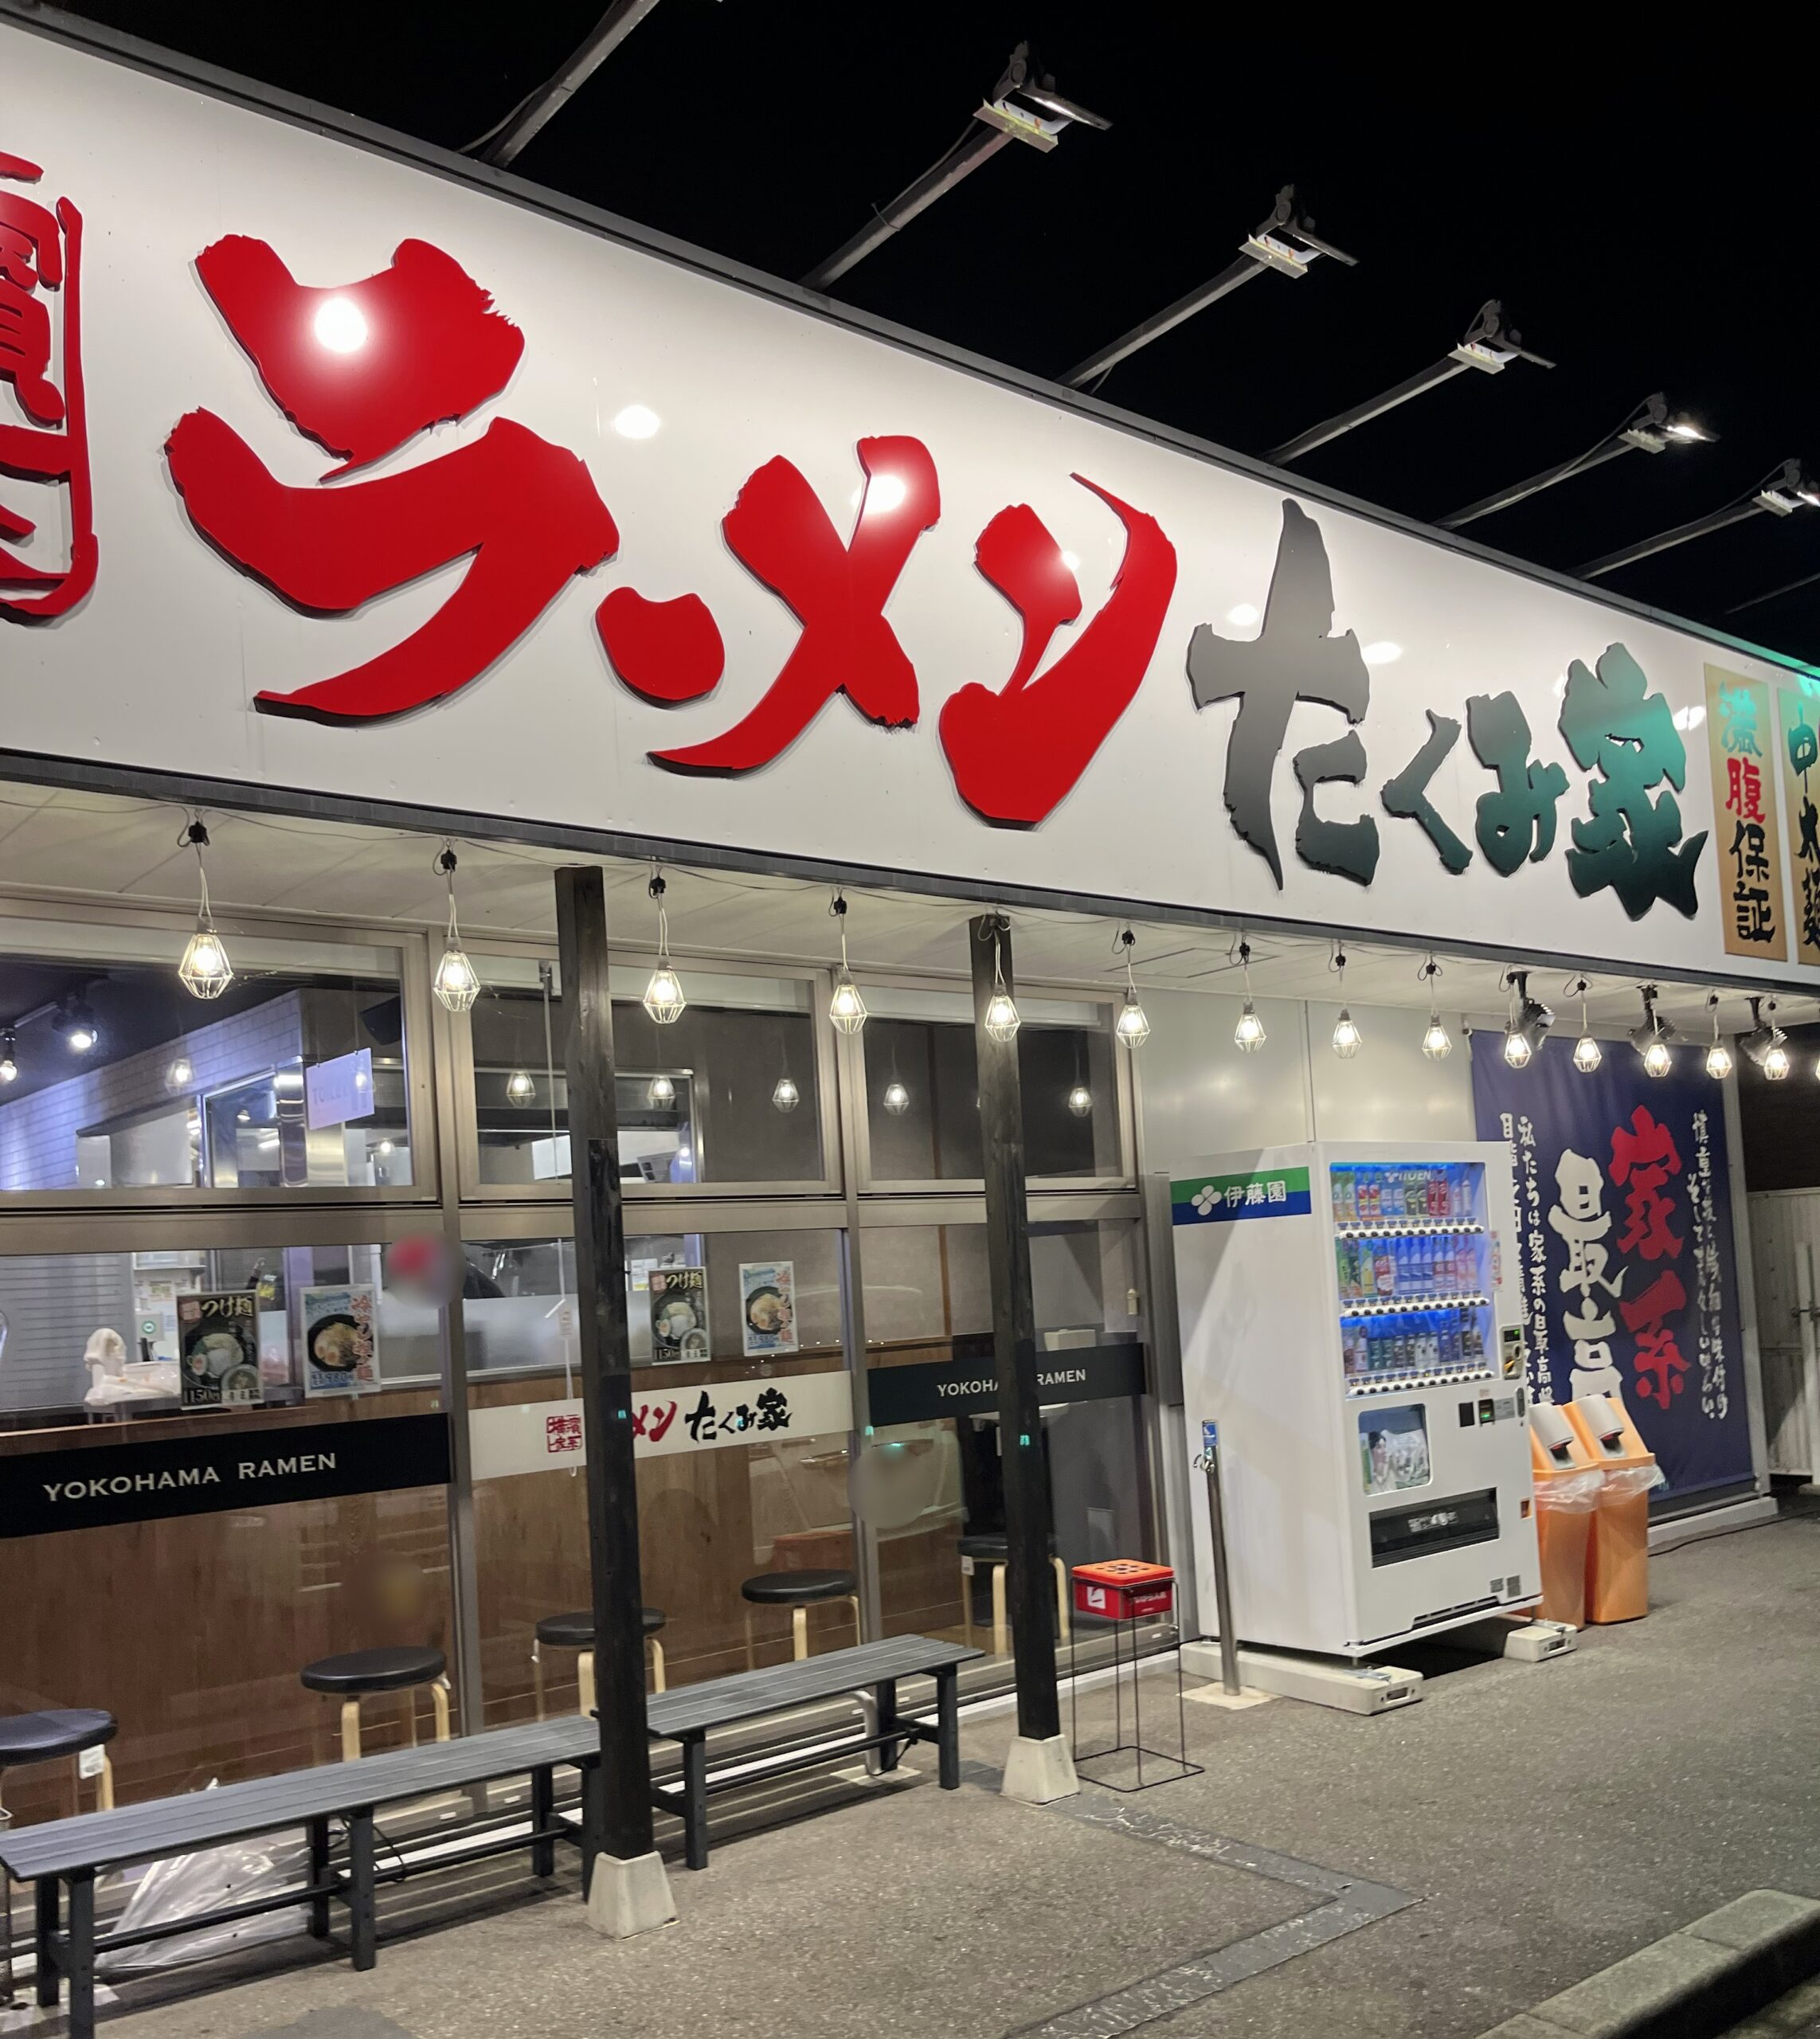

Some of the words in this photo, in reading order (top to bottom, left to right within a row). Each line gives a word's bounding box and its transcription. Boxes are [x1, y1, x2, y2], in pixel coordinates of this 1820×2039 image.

[1223, 1180, 1287, 1208] 伊藤園
[1608, 1105, 1691, 1409] 家系
[937, 1379, 999, 1397] YOKOH
[1037, 1368, 1086, 1386] RAMEN
[632, 1400, 677, 1442] メン
[684, 1387, 793, 1445] たくみ家
[42, 1466, 221, 1502] YOKOHAMA
[238, 1453, 336, 1480] RAMEN
